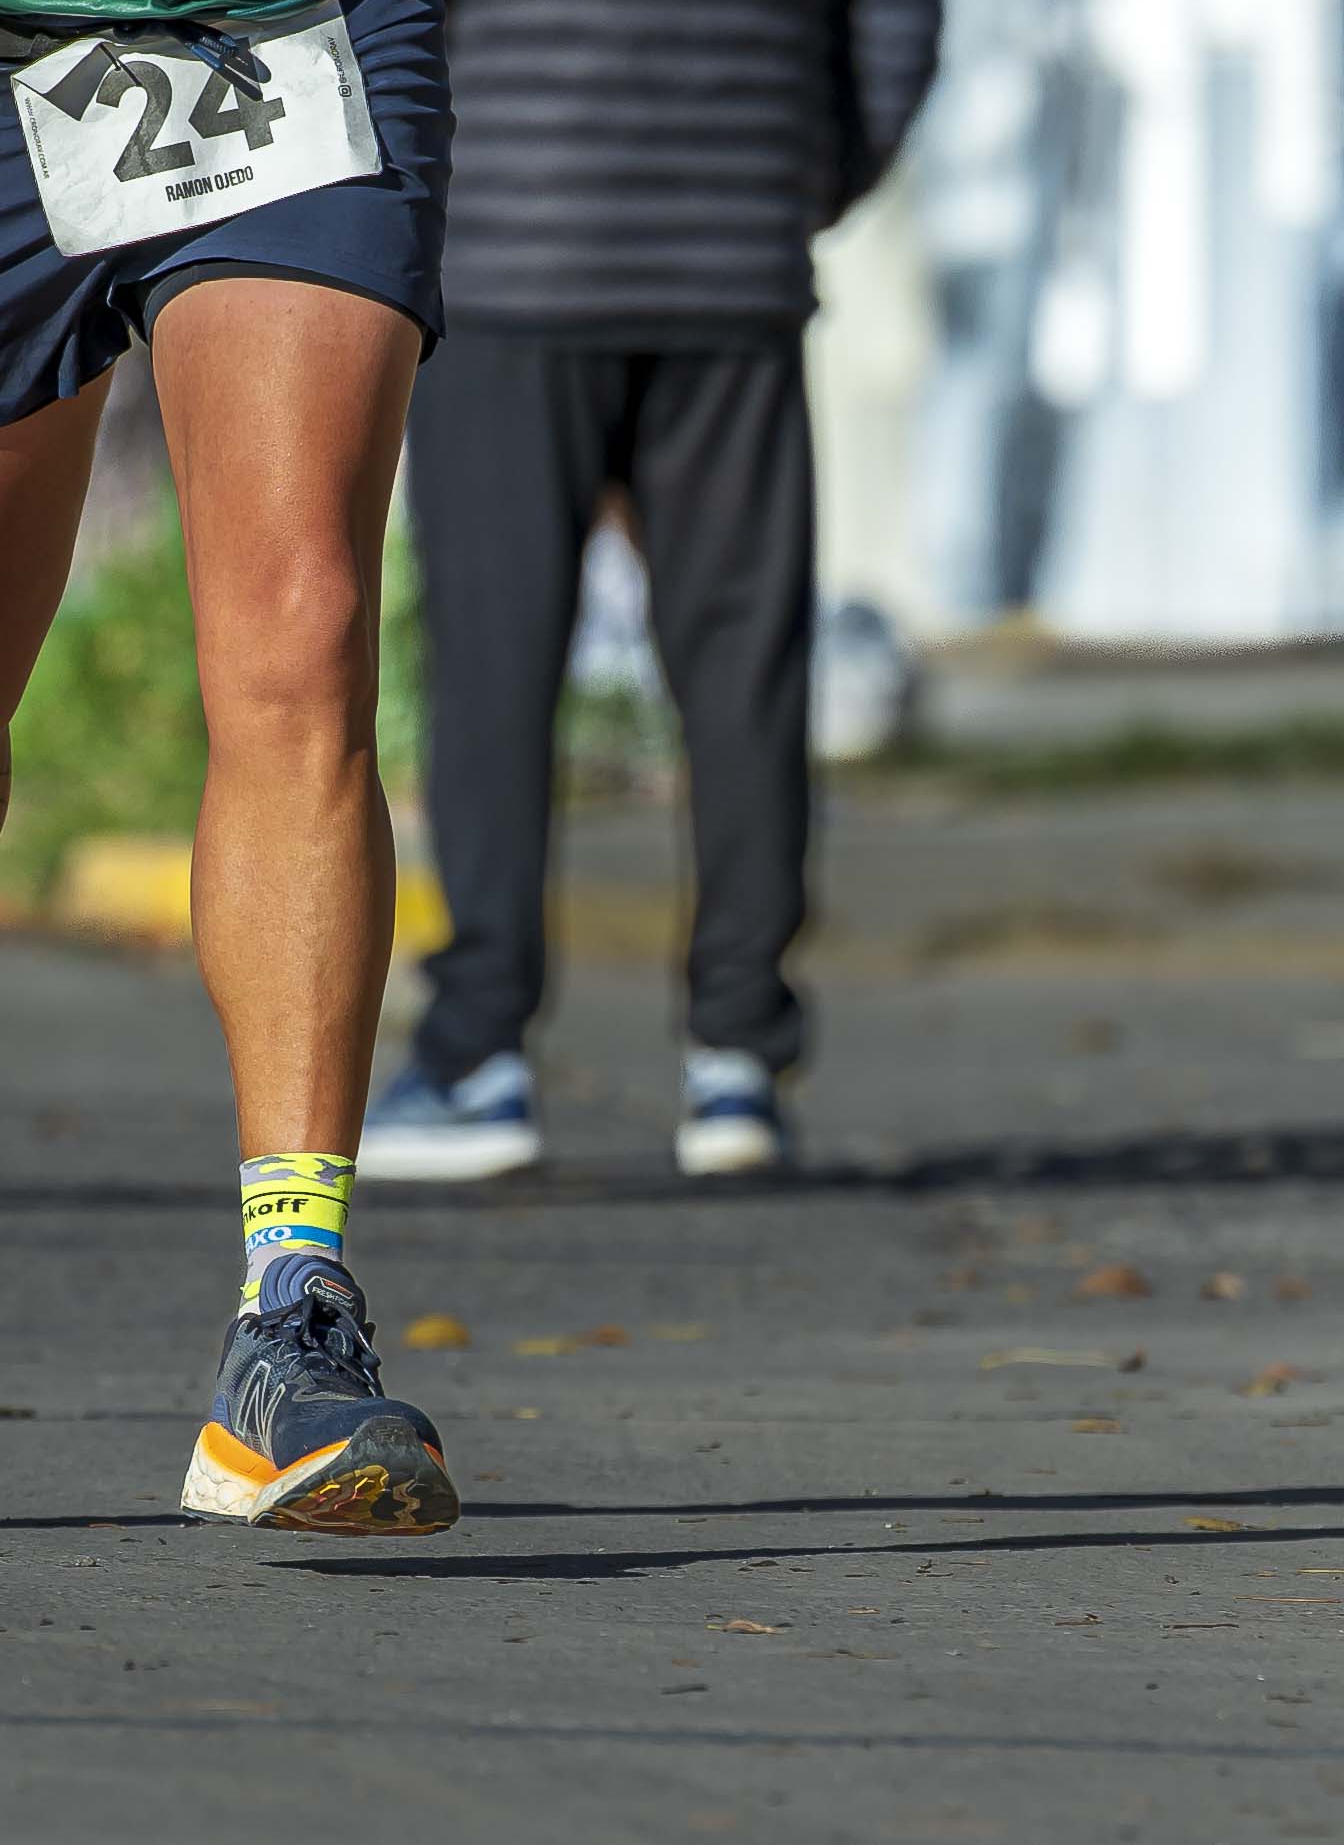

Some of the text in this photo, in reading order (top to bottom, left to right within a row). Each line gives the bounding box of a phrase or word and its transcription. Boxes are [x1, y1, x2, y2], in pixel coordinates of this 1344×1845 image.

[96, 36, 286, 183] 24
[165, 165, 254, 203] RAMON OJEDO
